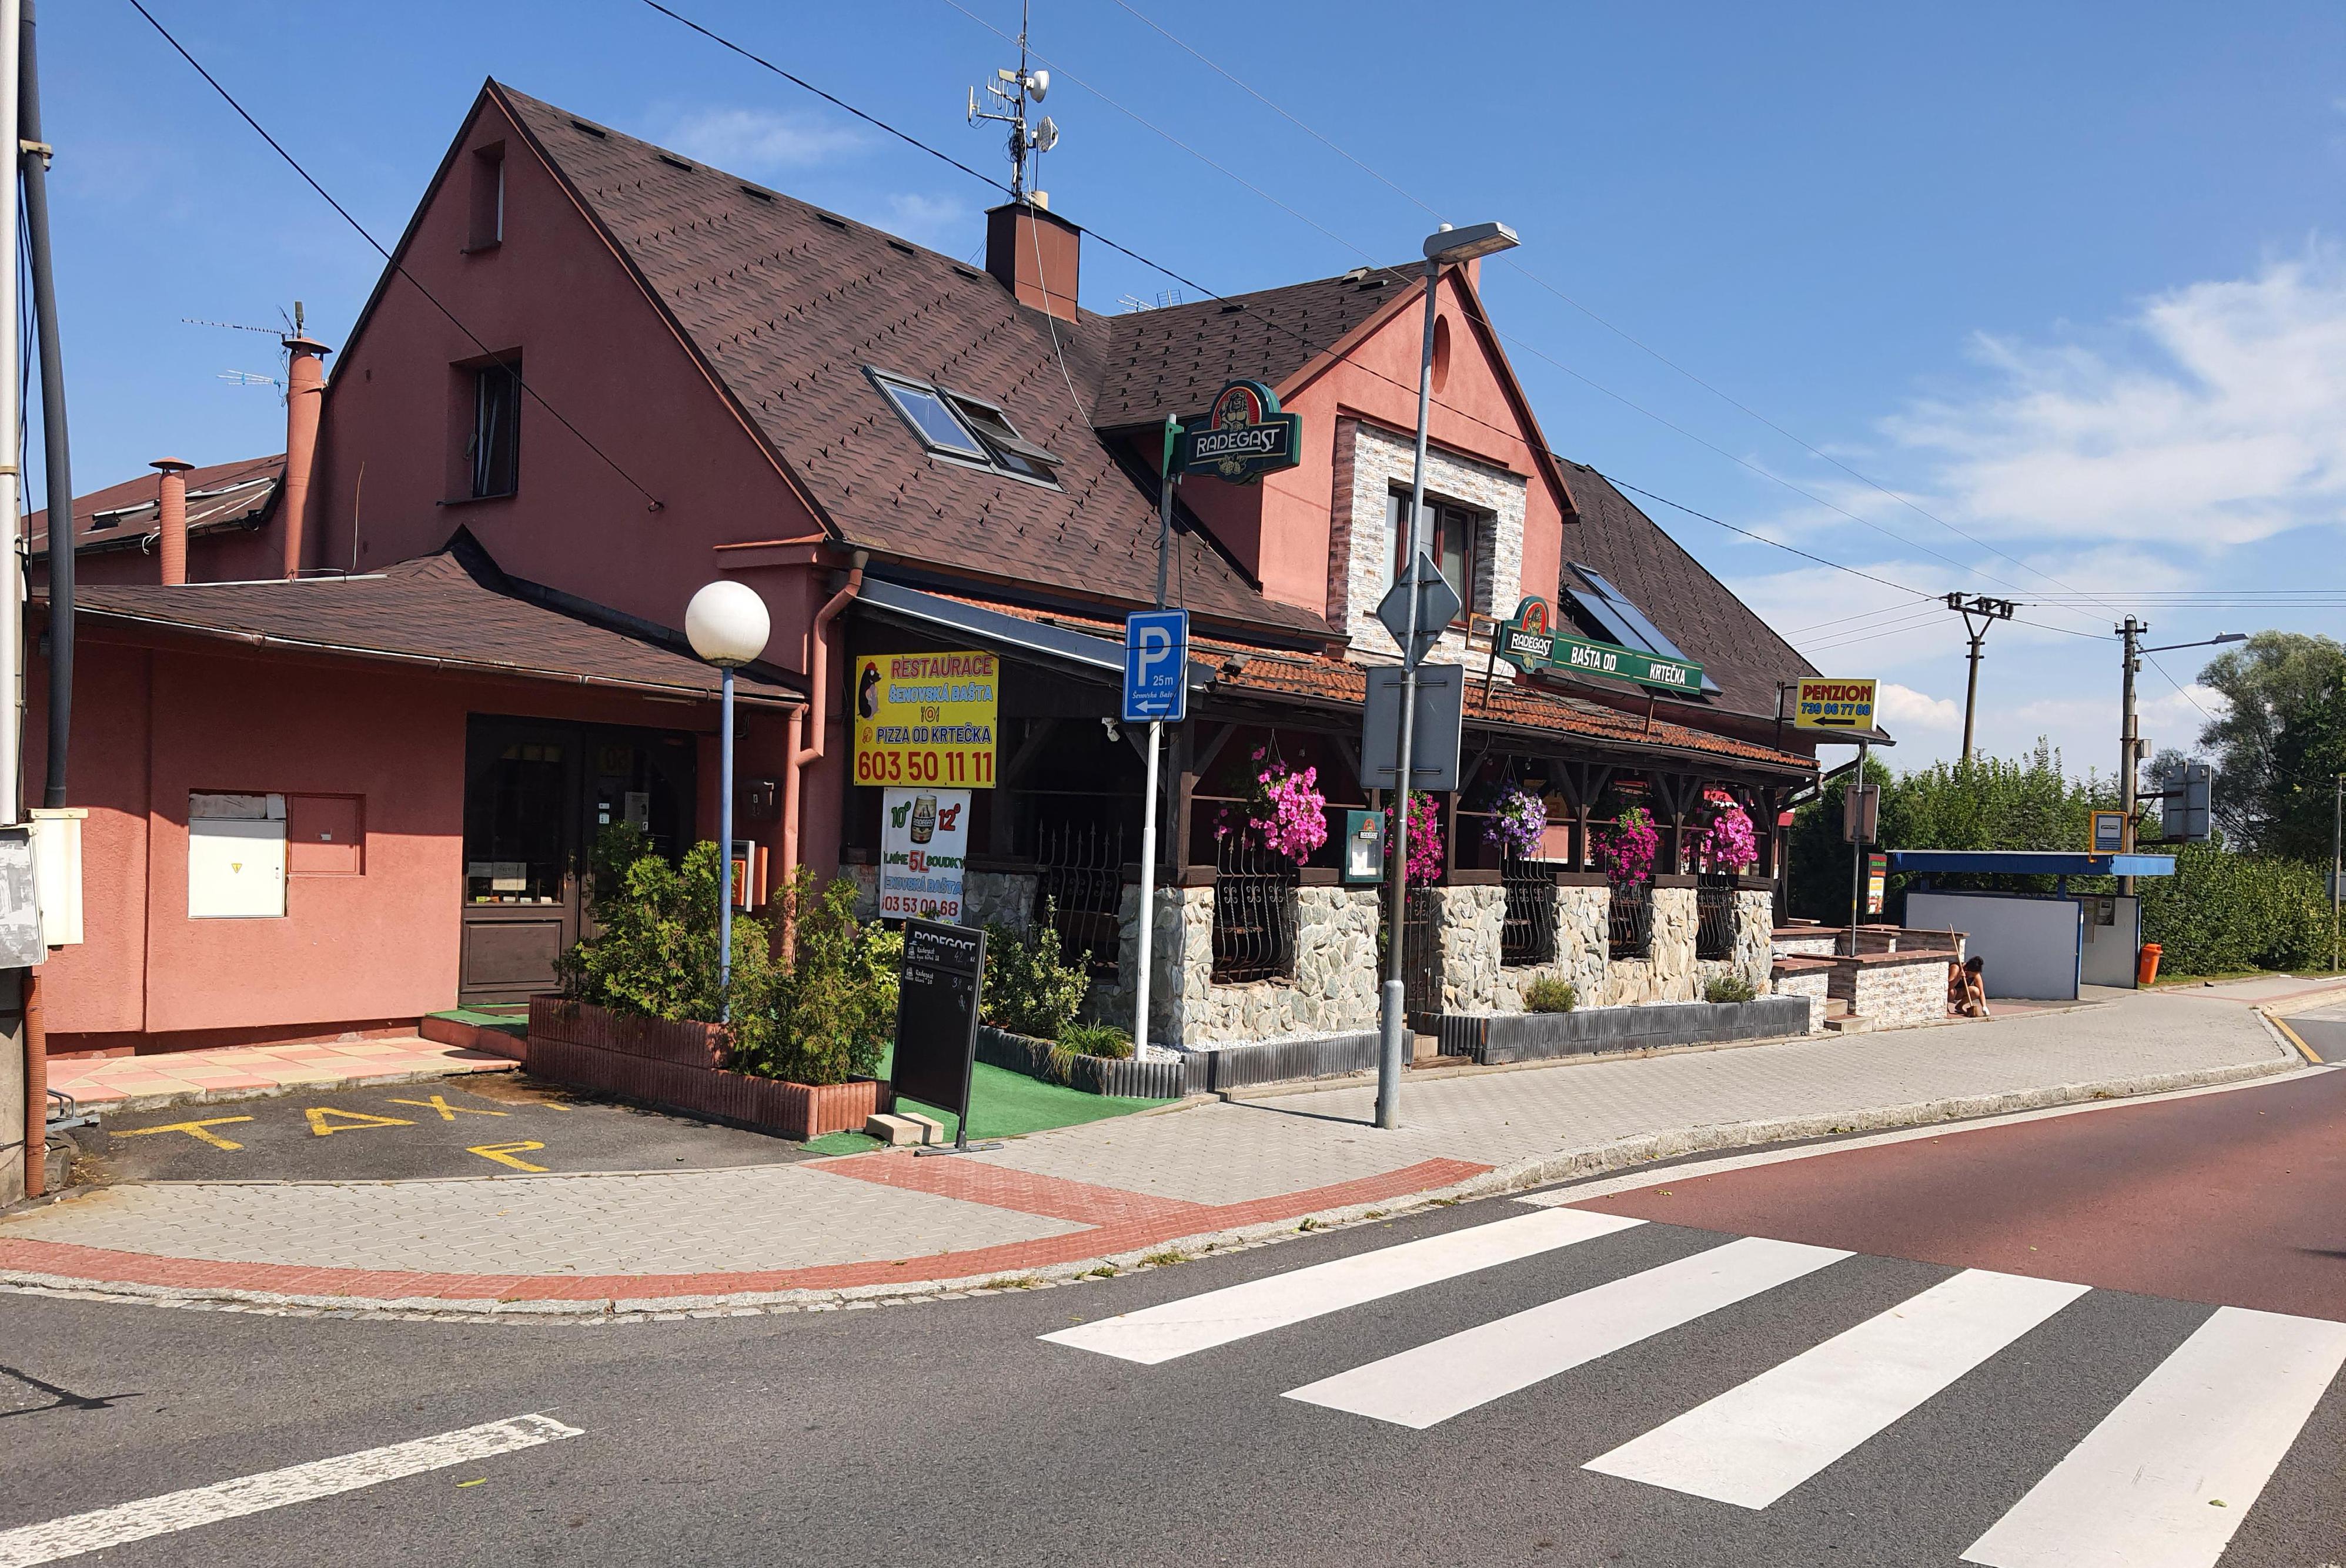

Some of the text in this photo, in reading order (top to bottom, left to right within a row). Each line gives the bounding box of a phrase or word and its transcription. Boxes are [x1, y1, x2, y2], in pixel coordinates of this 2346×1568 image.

[1197, 429, 1280, 458] RADEGAST
[891, 656, 994, 679] RESTAURACE
[1138, 626, 1171, 687] P
[1511, 633, 1685, 685] RADEGAST BAŠTA OD KRTEČKA
[888, 682, 994, 703] ŠENOVSKÁ BAŠTA
[1802, 685, 1872, 701] PENZION
[1801, 703, 1871, 716] 739 06 77 88
[877, 723, 992, 744] PIZZA OD KRTEČKA
[858, 751, 992, 782] 603 50 11 11
[884, 851, 908, 865] LNÍME
[909, 850, 930, 873] 5L
[885, 875, 963, 895] ENOVSKÁ BAŠTA
[903, 897, 917, 913] 53
[940, 900, 958, 917] 68
